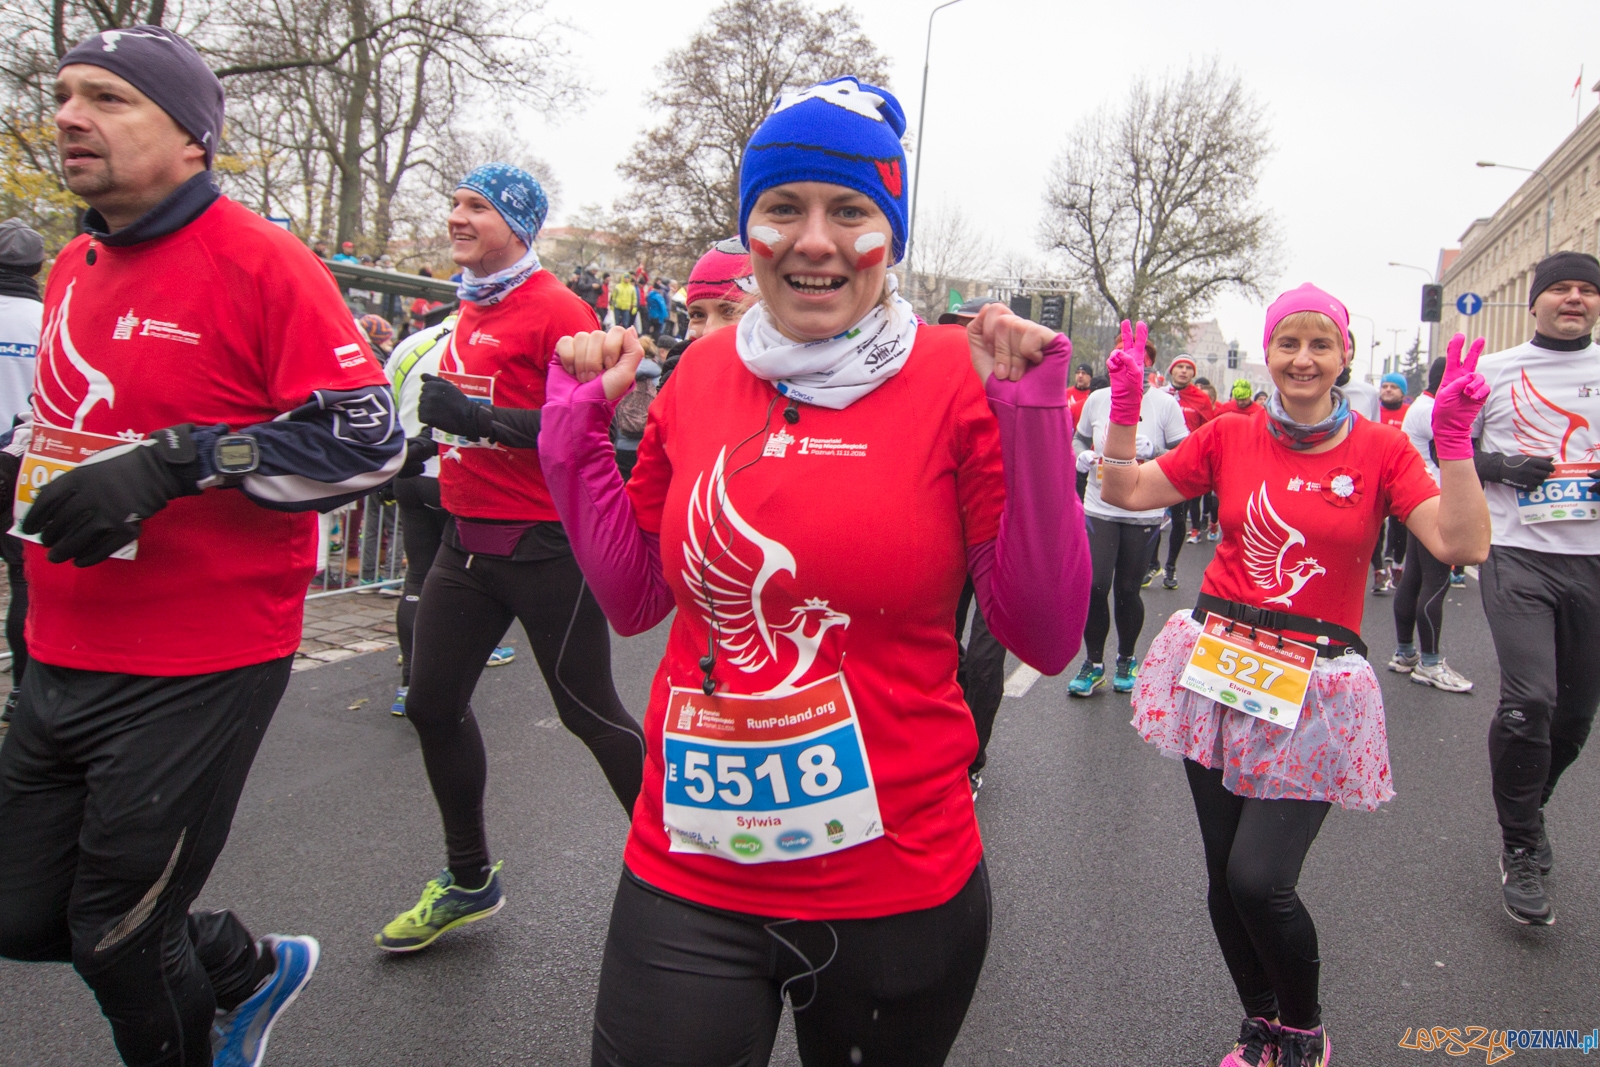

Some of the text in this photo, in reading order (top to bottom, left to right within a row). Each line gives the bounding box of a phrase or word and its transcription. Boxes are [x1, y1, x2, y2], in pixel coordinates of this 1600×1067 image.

[797, 436, 810, 455] 1
[1529, 482, 1597, 503] 8647
[1196, 646, 1207, 656] D
[1215, 647, 1285, 691] 527
[1228, 682, 1252, 696] Elwira
[747, 701, 836, 730] RunPoland.org
[668, 763, 678, 783] E
[684, 744, 843, 806] 5518
[736, 815, 782, 830] Sylwia
